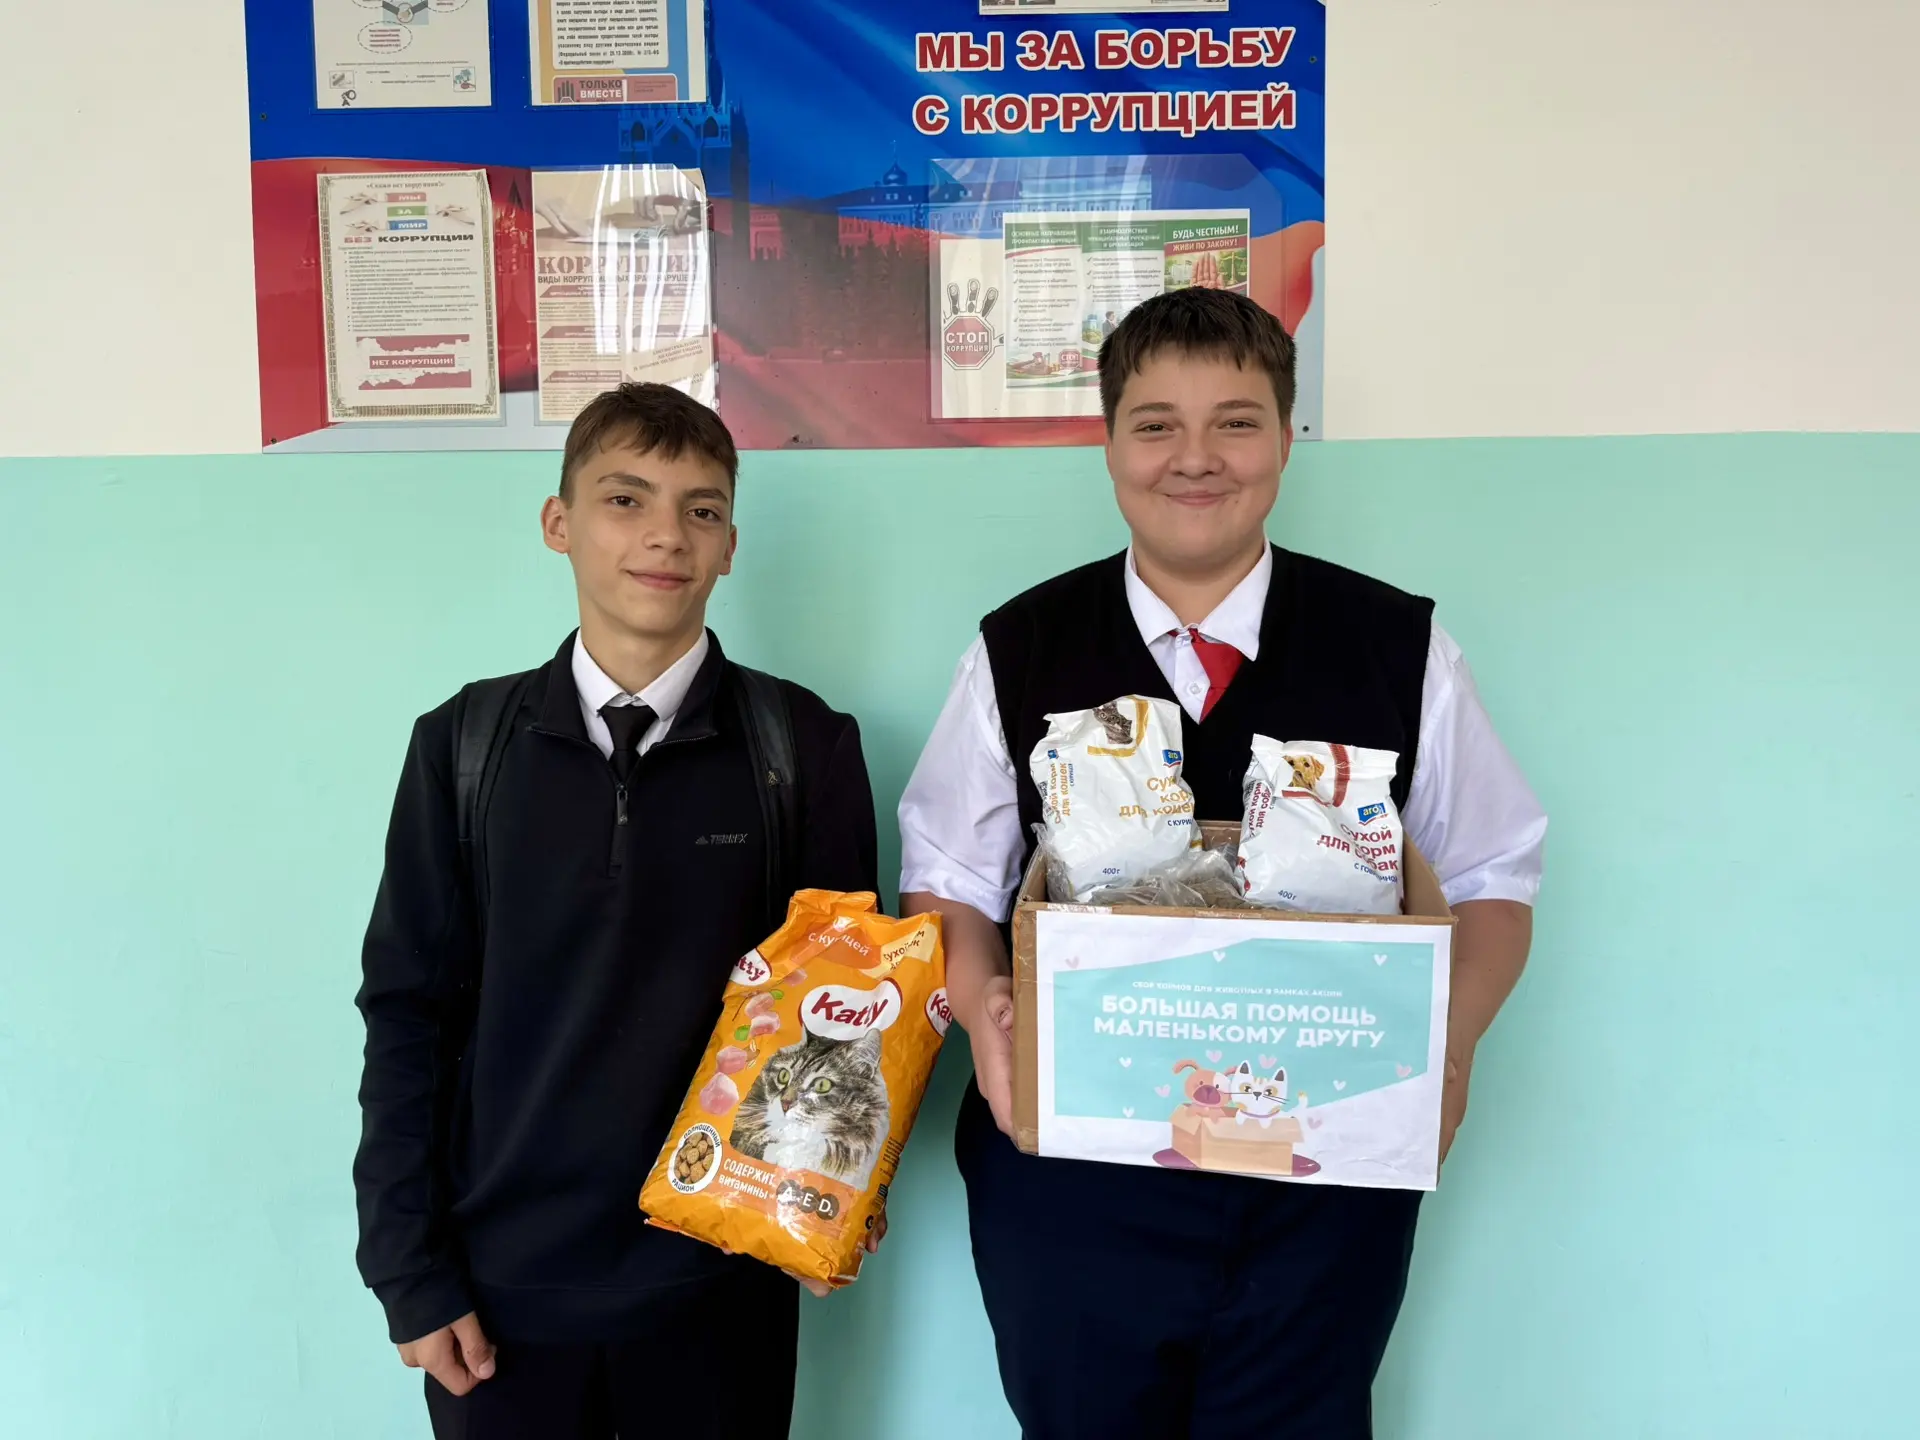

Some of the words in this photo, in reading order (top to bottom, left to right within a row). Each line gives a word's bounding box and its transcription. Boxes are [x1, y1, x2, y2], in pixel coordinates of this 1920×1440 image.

[917, 32, 1003, 71] МЫ
[1016, 31, 1084, 69] ЗА
[1096, 28, 1295, 68] БОРЬБУ
[579, 79, 622, 89] ТОЛЬКО
[580, 90, 622, 98] ВМЕСТЕ
[913, 95, 948, 134] С
[963, 83, 1295, 136] КОРРУПЦИЕЙ
[378, 234, 474, 243] КОРРУПЦИИ
[1172, 230, 1195, 240] БУДЬ
[1196, 224, 1239, 237] ЧЕСТНЫМ!
[1173, 243, 1194, 252] ЖИВИ
[1207, 238, 1238, 249] ЗАКОНУ!
[537, 256, 698, 274] КОРРПЦИ
[538, 276, 561, 284] ВИДЫ
[946, 331, 988, 344] СТОП
[1060, 763, 1069, 795] кошек
[1146, 775, 1177, 791] Сух
[1160, 789, 1193, 804] кор
[1260, 786, 1271, 809] соба
[1062, 798, 1071, 817] для
[1363, 805, 1379, 816] aro
[1256, 810, 1266, 828] для
[1340, 823, 1392, 843] Сухой
[1316, 834, 1350, 853] для
[1354, 843, 1396, 859] орм
[819, 934, 869, 956] куцей
[739, 956, 766, 982] tty
[1193, 985, 1212, 993] ДЛЯ
[1273, 988, 1309, 996] РАМКАХ
[1102, 994, 1237, 1020] БОЛЬШАЯ
[1247, 1002, 1376, 1027] ПОМОЩЬ
[1094, 1016, 1287, 1044] МАЛЕНЬКОМУ
[1296, 1027, 1385, 1048] ДРУГУ
[683, 1123, 721, 1148] ПОЛНОЦЕННЫЙ
[723, 1158, 776, 1185] СОДЕРЖИТ
[671, 1179, 695, 1192] РАЦИОН
[718, 1175, 768, 1200] витамины
